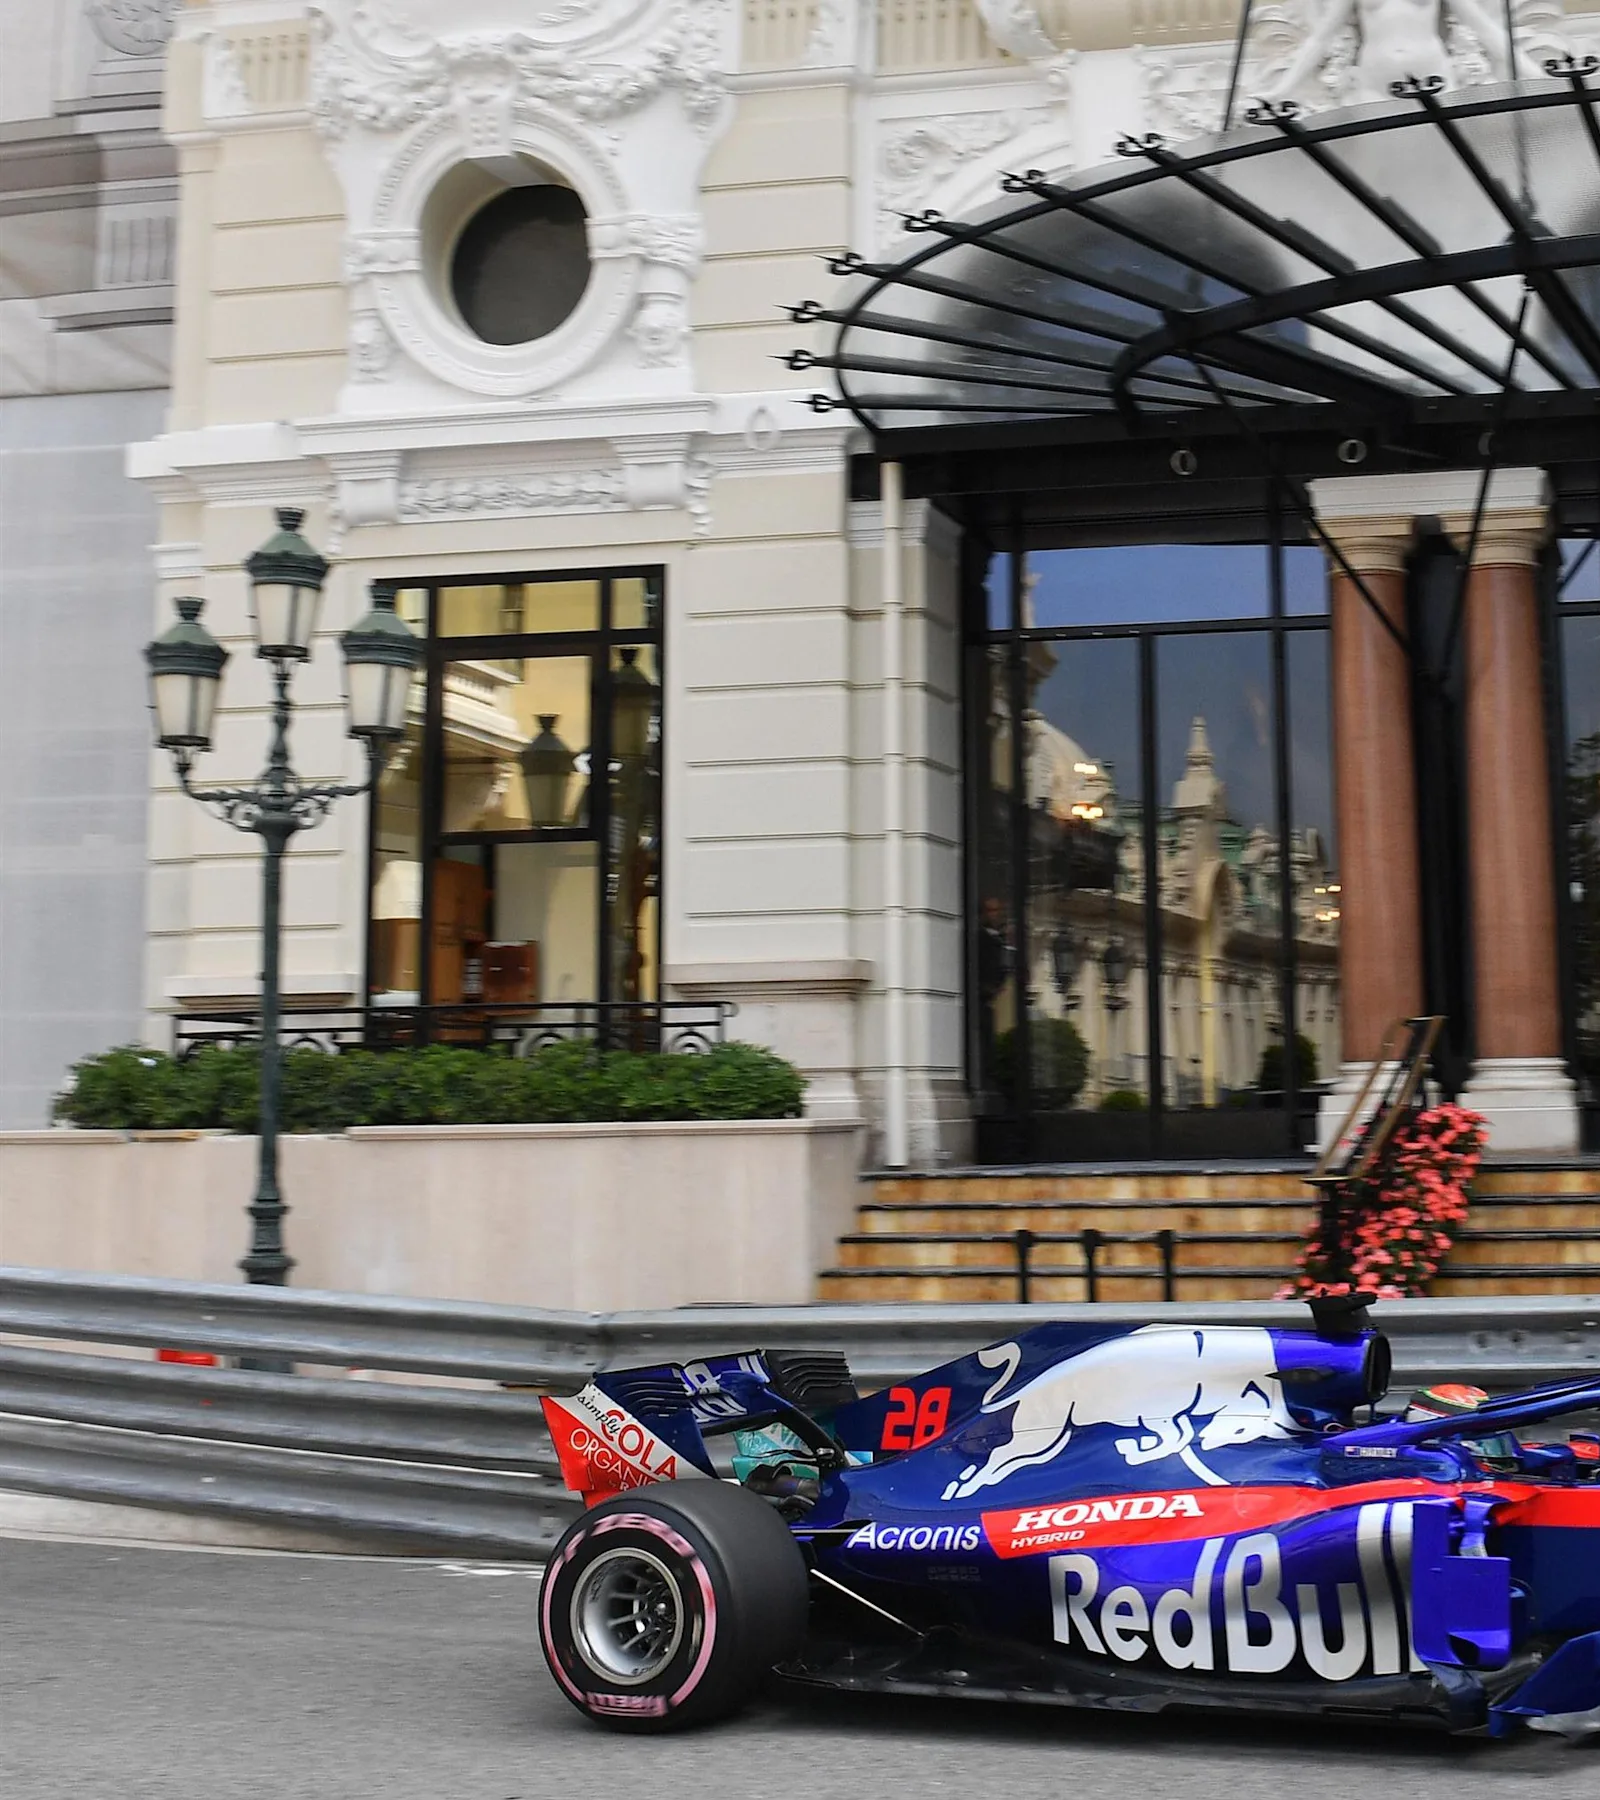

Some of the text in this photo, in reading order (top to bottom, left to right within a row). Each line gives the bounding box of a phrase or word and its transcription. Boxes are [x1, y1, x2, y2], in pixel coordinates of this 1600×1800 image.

[576, 1395, 621, 1435] simply
[601, 1408, 677, 1480] COLA
[880, 1386, 952, 1451] 28
[570, 1428, 656, 1487] ORGANI
[846, 1522, 981, 1550] Acronis
[1010, 1493, 1204, 1532] HONDA
[1010, 1529, 1085, 1549] HYBRID
